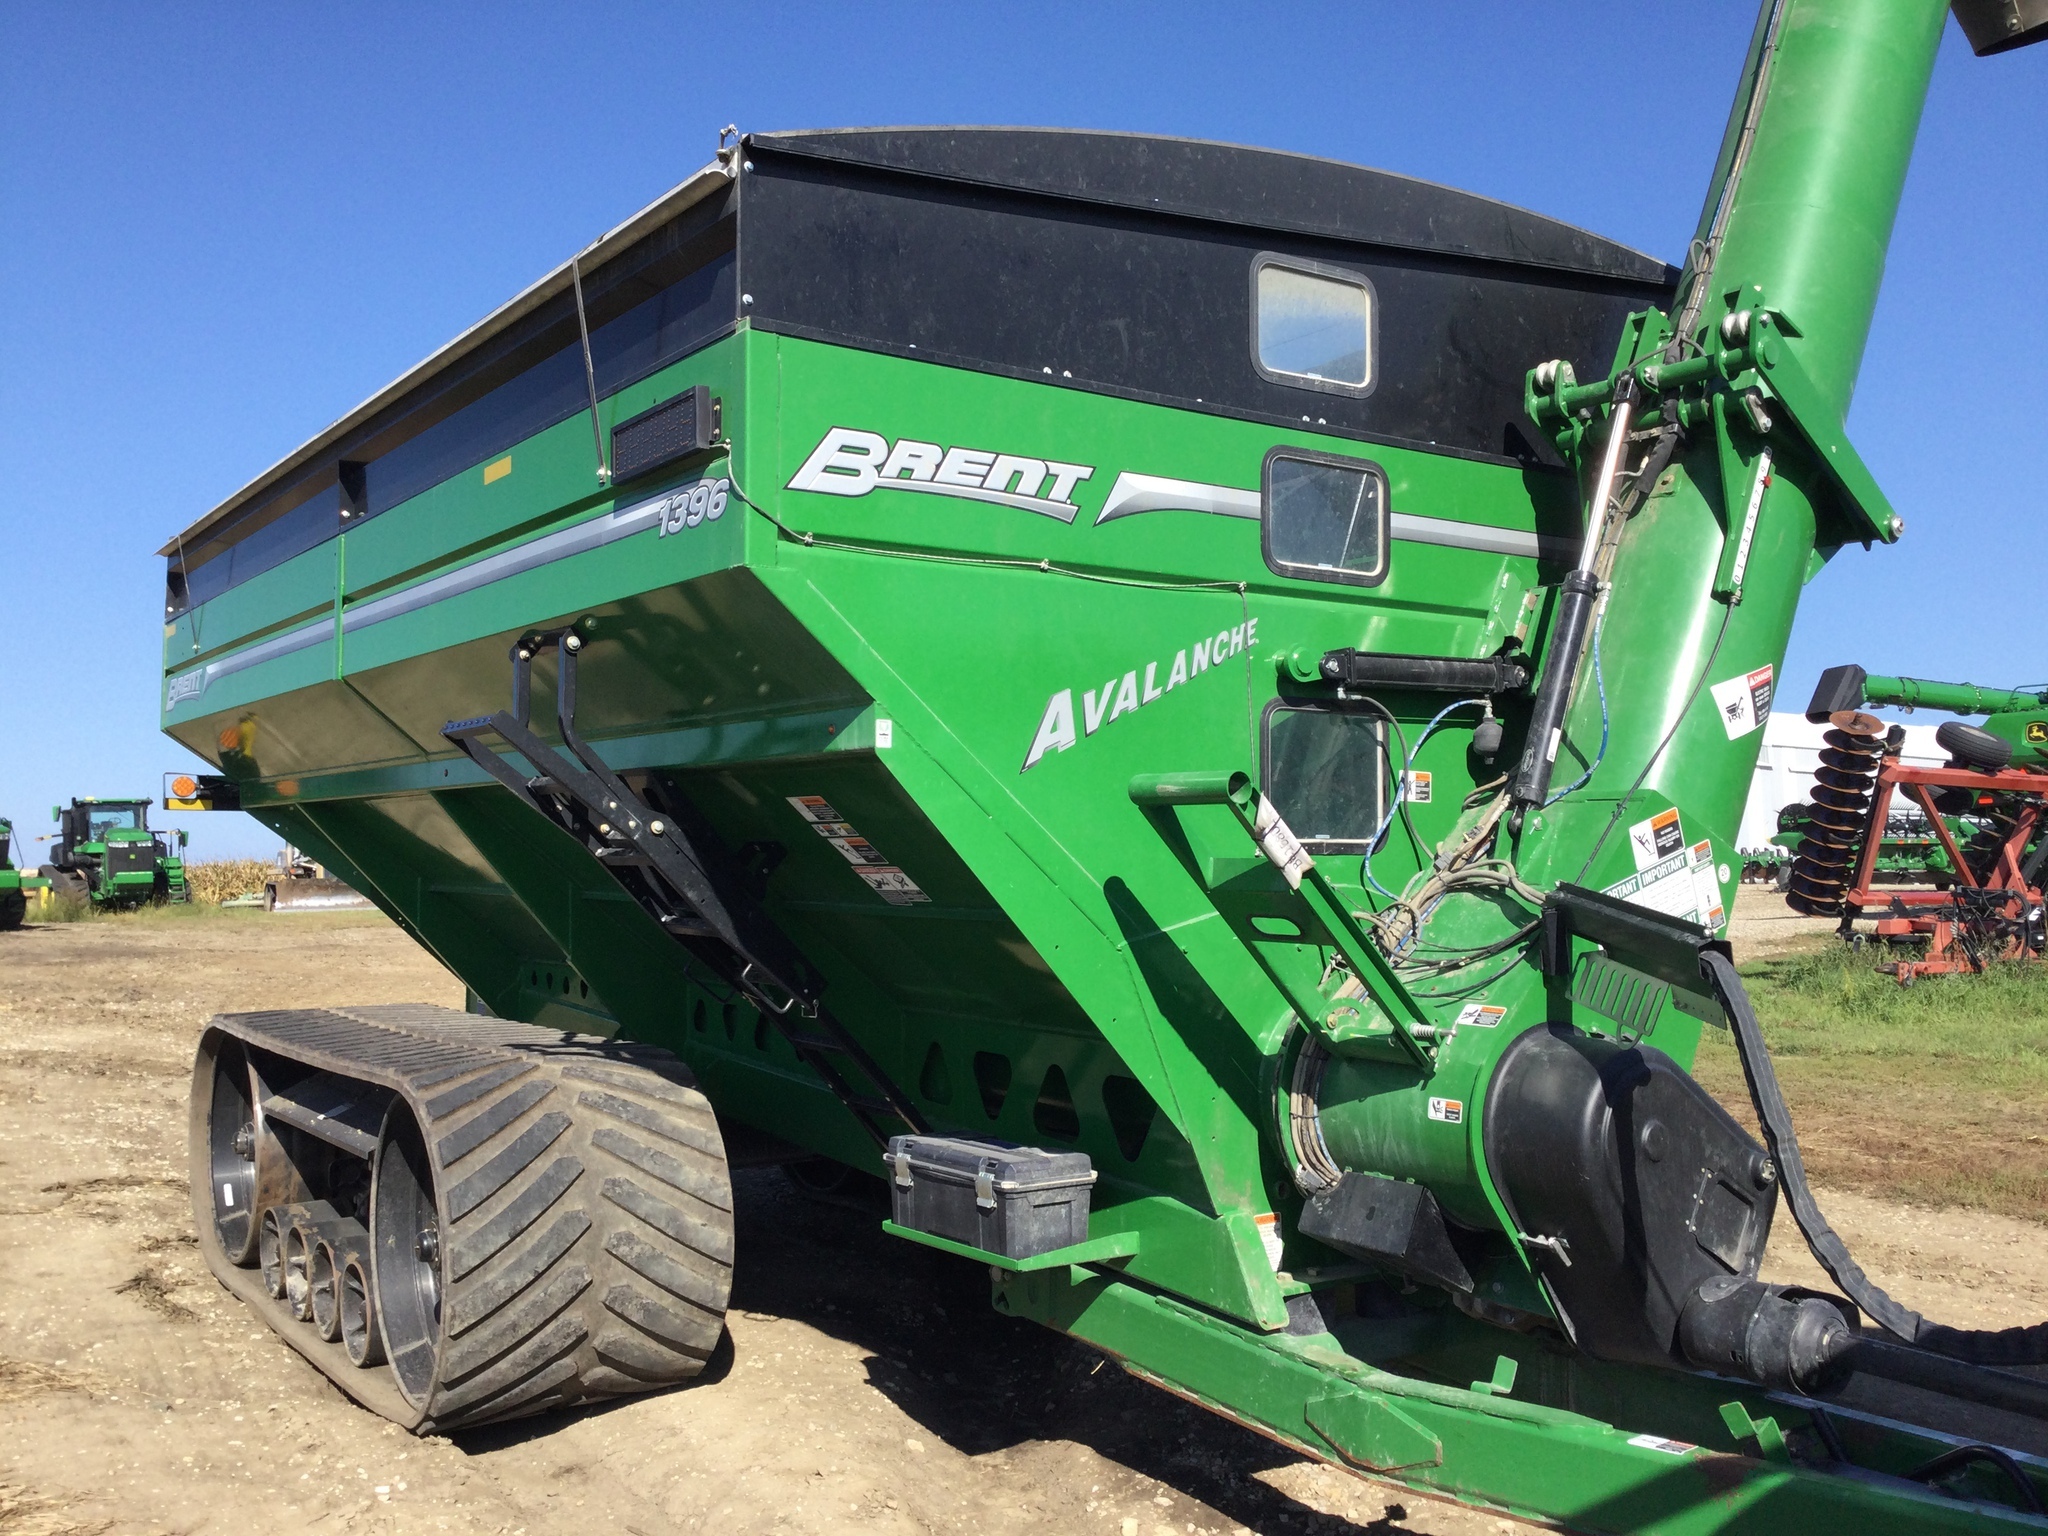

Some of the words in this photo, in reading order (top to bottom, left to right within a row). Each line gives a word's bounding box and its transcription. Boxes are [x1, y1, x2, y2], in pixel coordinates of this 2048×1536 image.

[658, 477, 730, 538] 1396
[1020, 617, 1259, 775] AVALANCHE
[1641, 854, 1686, 886] IMPORTANT
